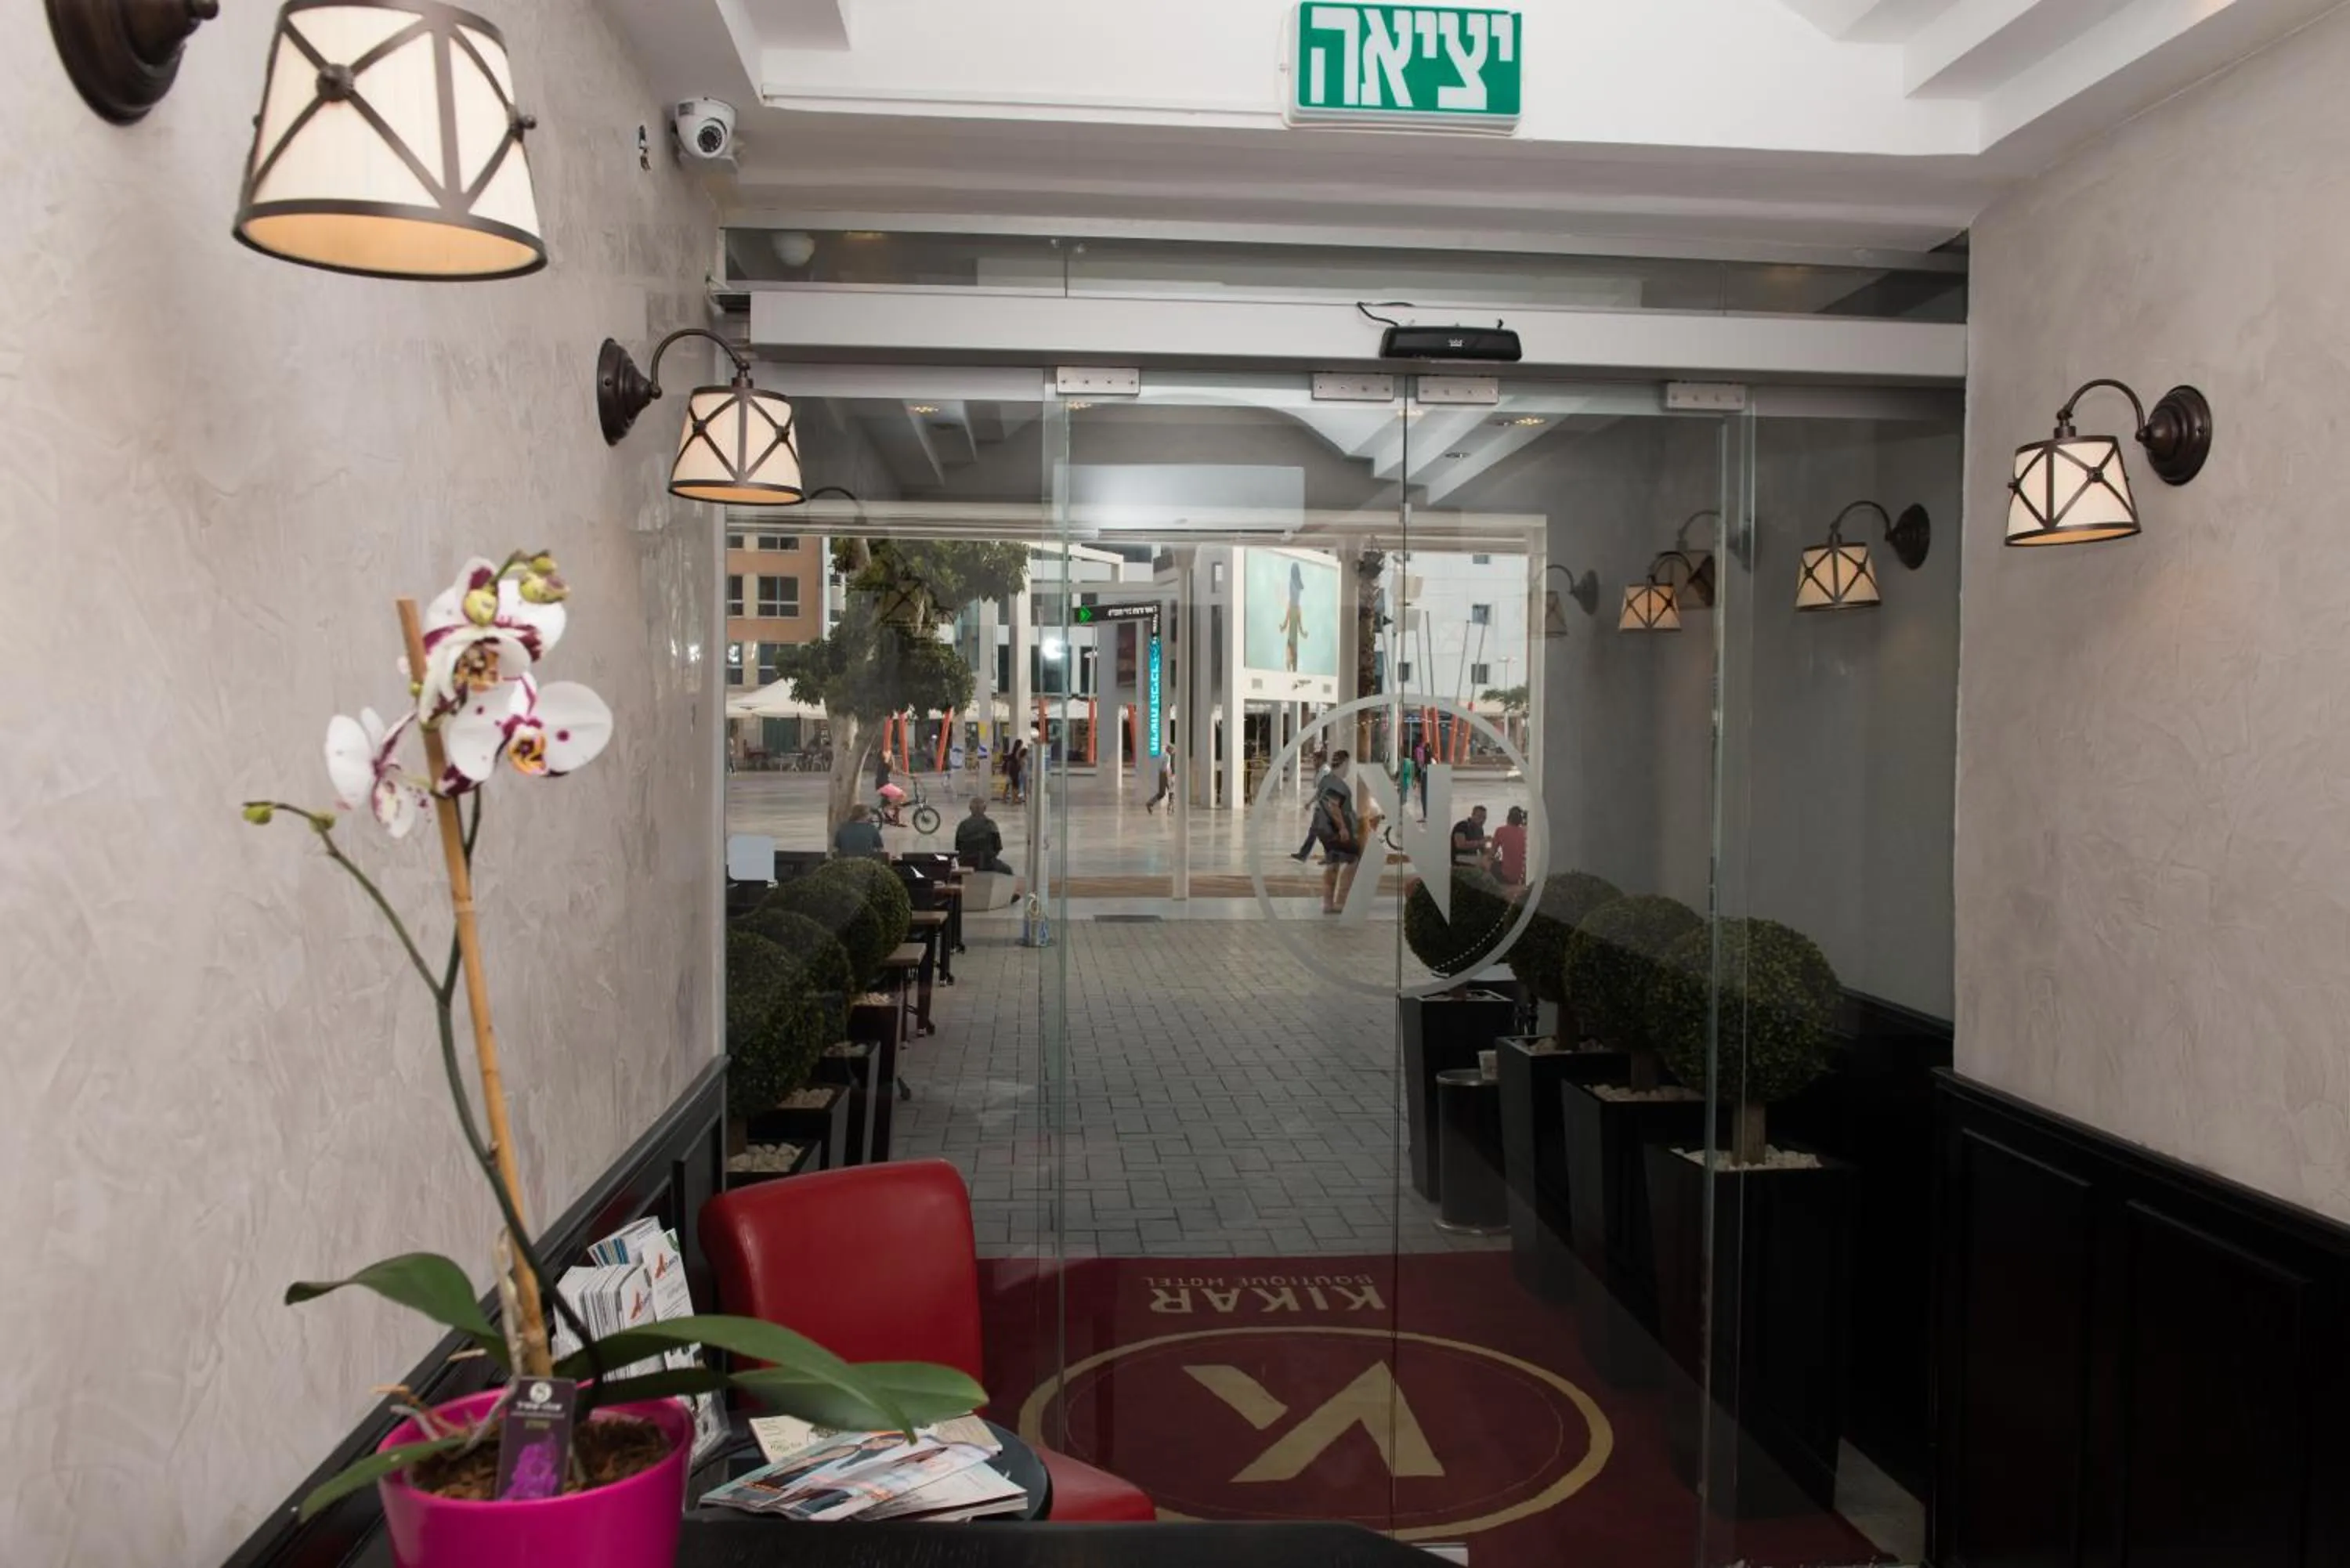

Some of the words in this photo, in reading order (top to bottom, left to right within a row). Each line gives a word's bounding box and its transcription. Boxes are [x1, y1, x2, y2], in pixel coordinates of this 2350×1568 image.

[1311, 6, 1513, 110] יציאה
[1143, 1276, 1224, 1287] HOTEL
[1235, 1275, 1373, 1287] BOUTIQUE
[1149, 1285, 1386, 1313] KIKAR
